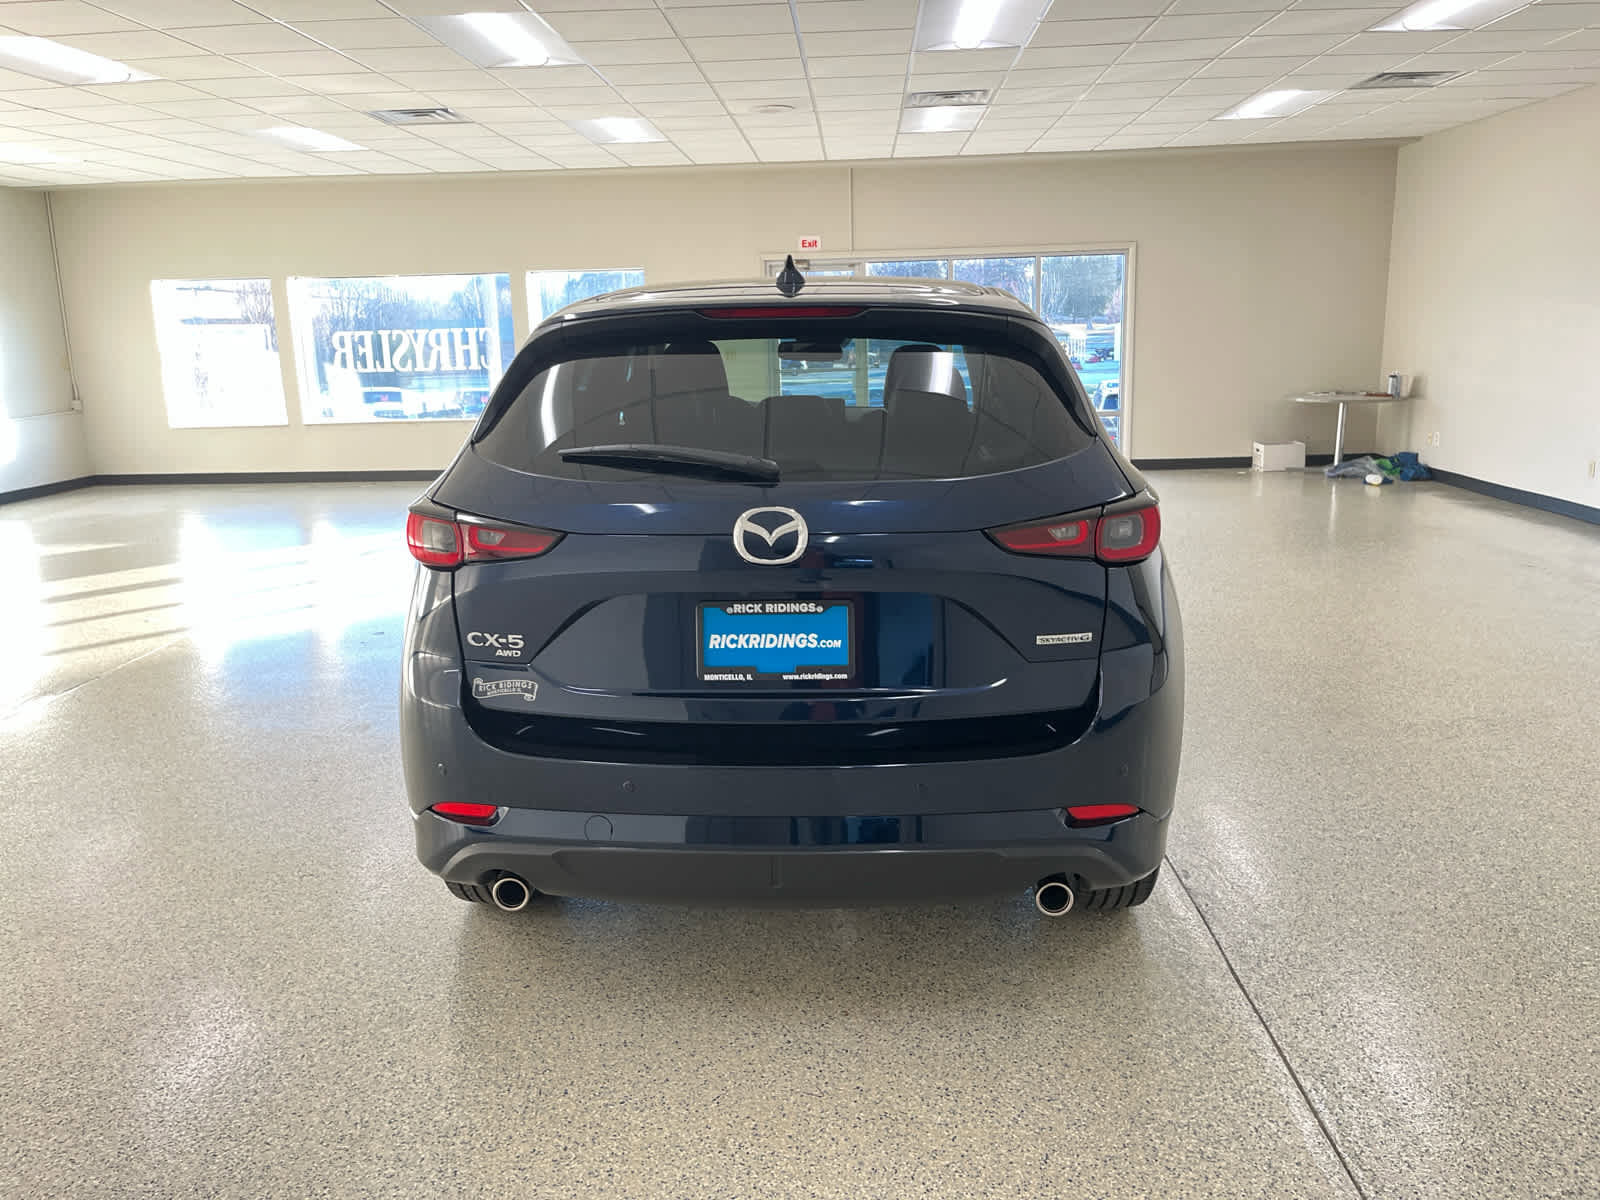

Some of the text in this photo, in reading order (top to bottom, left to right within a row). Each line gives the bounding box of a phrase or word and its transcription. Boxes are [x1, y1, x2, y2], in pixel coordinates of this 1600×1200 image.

[801, 239, 818, 249] Exit
[733, 602, 817, 614] RICK RIDINGS
[466, 631, 525, 649] CX-5
[495, 649, 521, 657] AWD
[782, 672, 848, 681] www.rickridings.com
